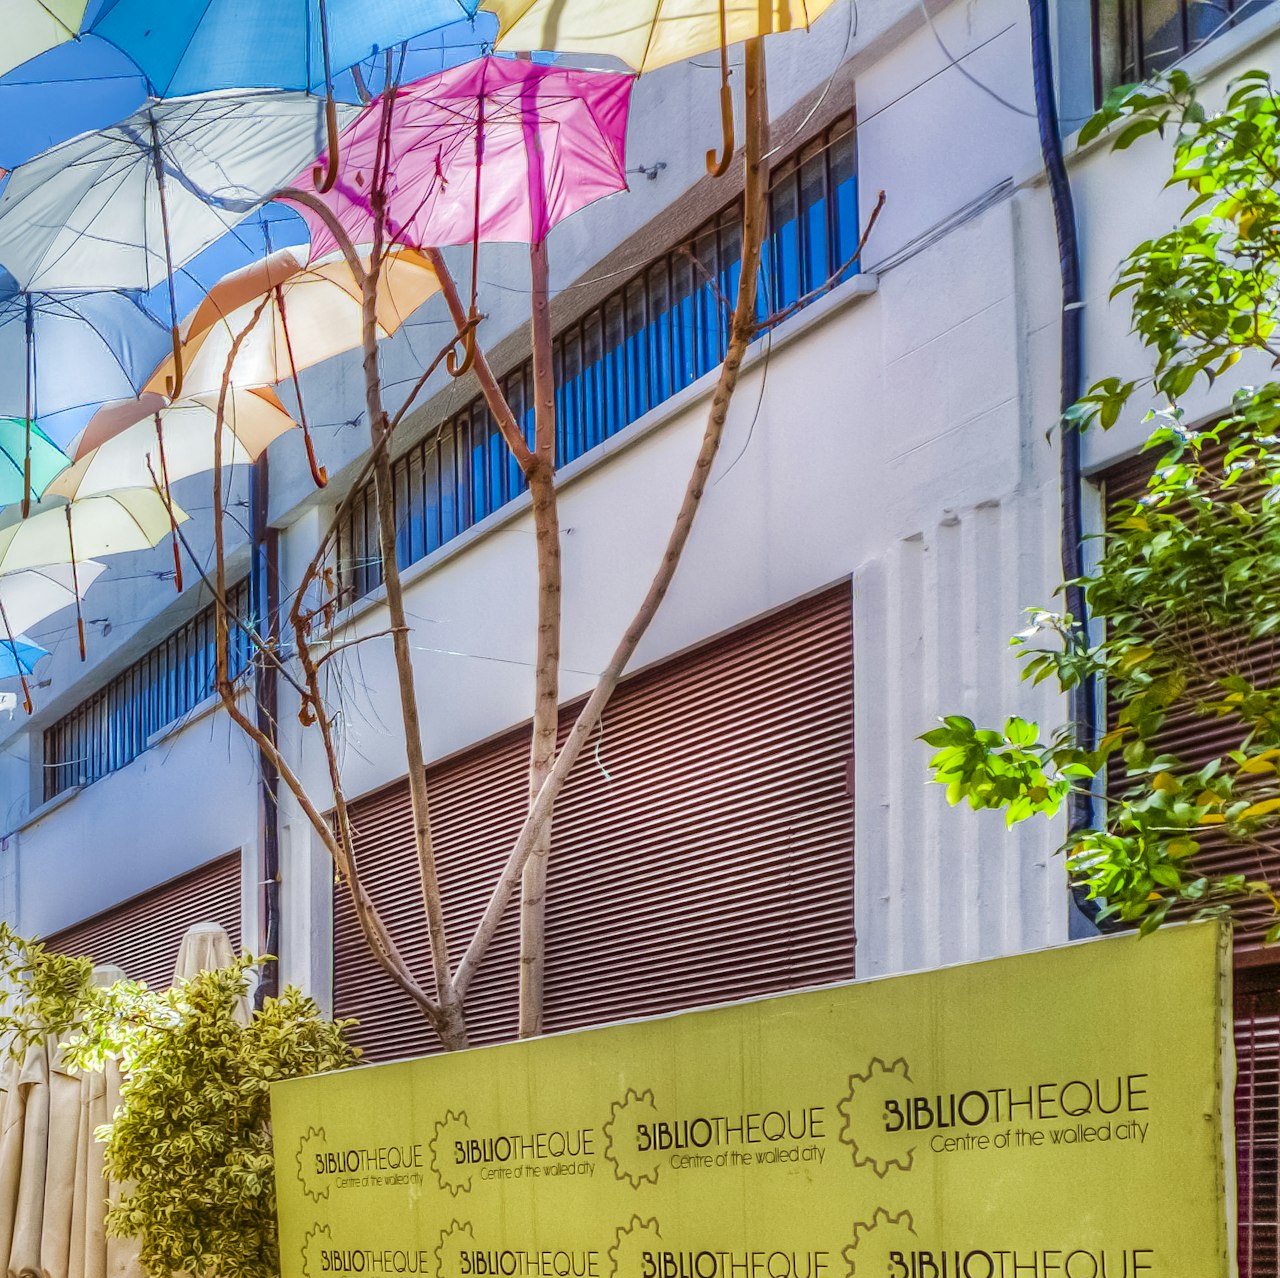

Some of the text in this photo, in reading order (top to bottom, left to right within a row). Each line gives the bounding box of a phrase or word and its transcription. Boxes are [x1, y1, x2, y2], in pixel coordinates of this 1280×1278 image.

[884, 1074, 1148, 1132] BIBLIOTHEQUE
[637, 1107, 823, 1151] BIBLIOTHEQUE
[930, 1120, 1149, 1153] Centre of the walled city
[316, 1145, 423, 1174] BIBLIOTHEQUE
[455, 1129, 594, 1164] BIBLIOTHEQUE
[669, 1145, 825, 1169] Centre of the walled city
[480, 1162, 594, 1180] Centre of the walled city
[321, 1250, 428, 1273] BIBLIOTHEQUE
[460, 1250, 599, 1277] BIBLIOTHEQUE
